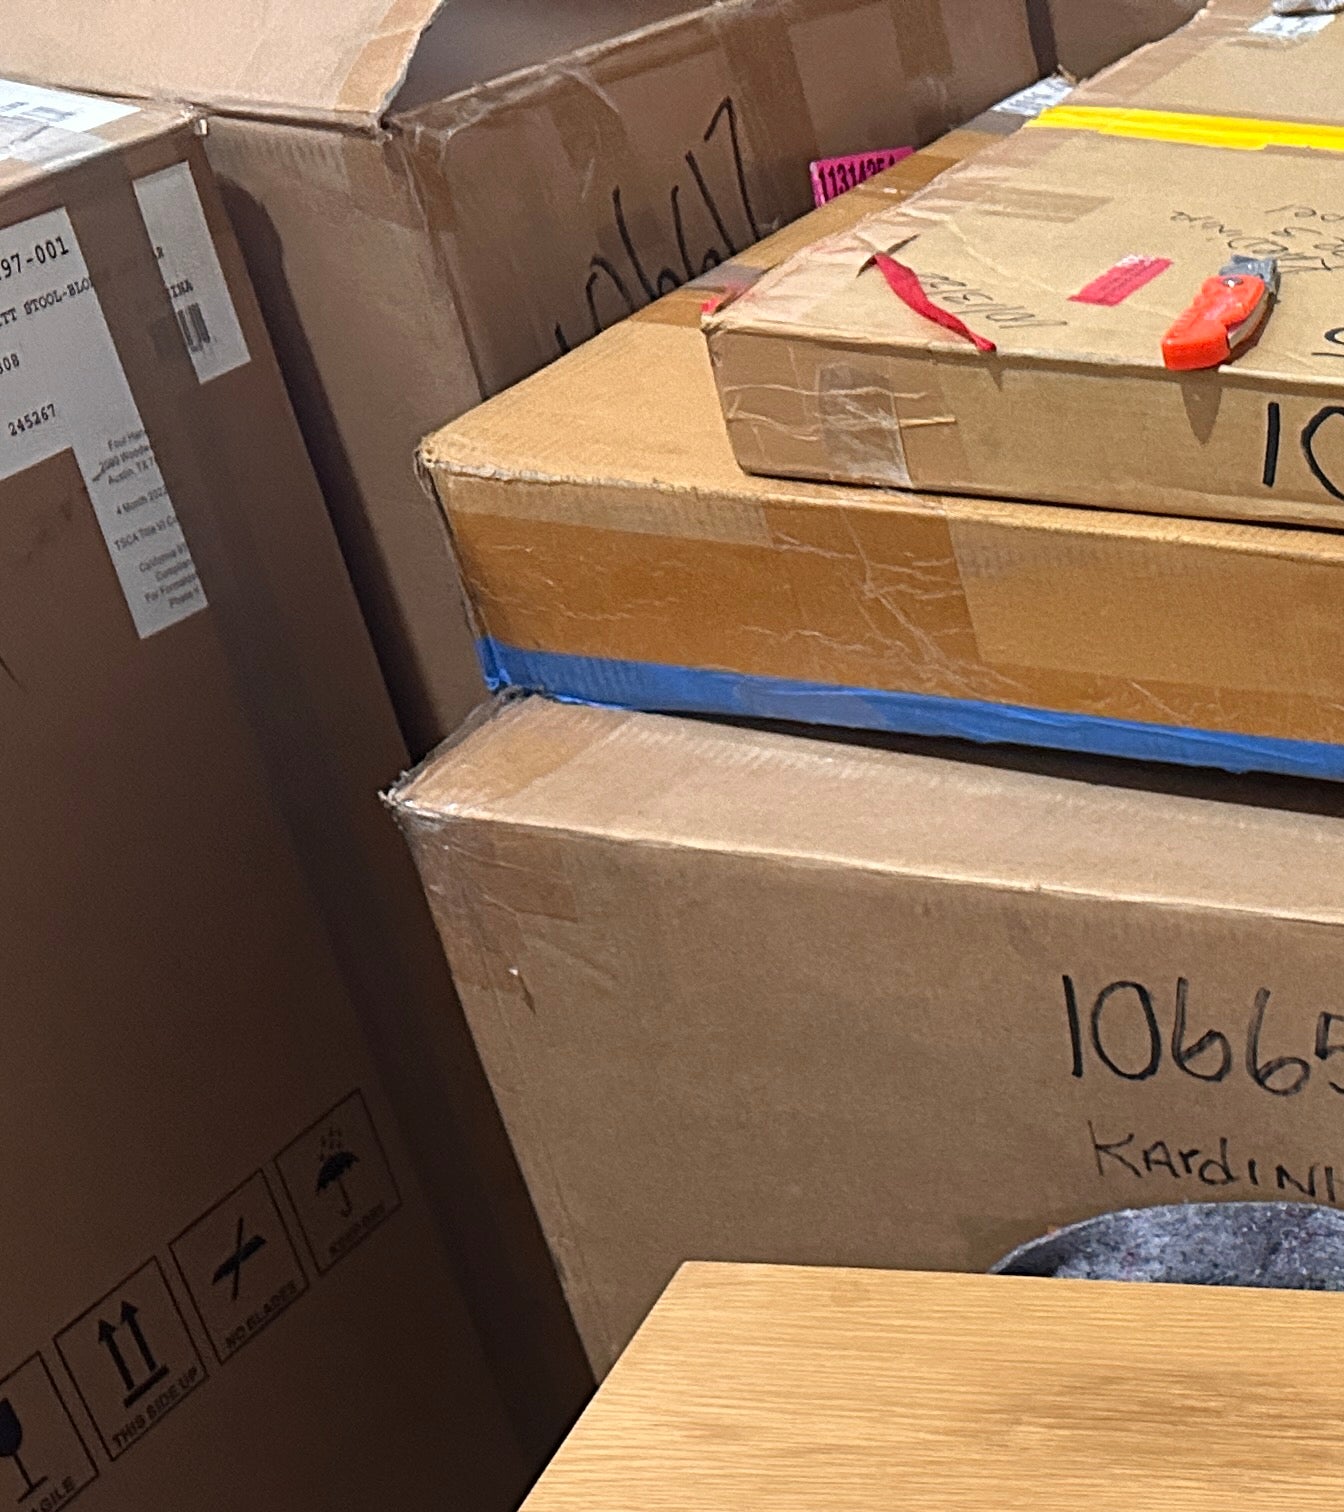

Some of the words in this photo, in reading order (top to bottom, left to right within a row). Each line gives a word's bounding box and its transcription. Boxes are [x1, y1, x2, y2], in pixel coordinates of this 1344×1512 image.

[0, 236, 69, 280] 97-001
[24, 277, 93, 316] STOOL-BLO
[8, 403, 56, 436] 245267
[110, 1410, 146, 1451] THIS
[177, 1364, 201, 1393] UP
